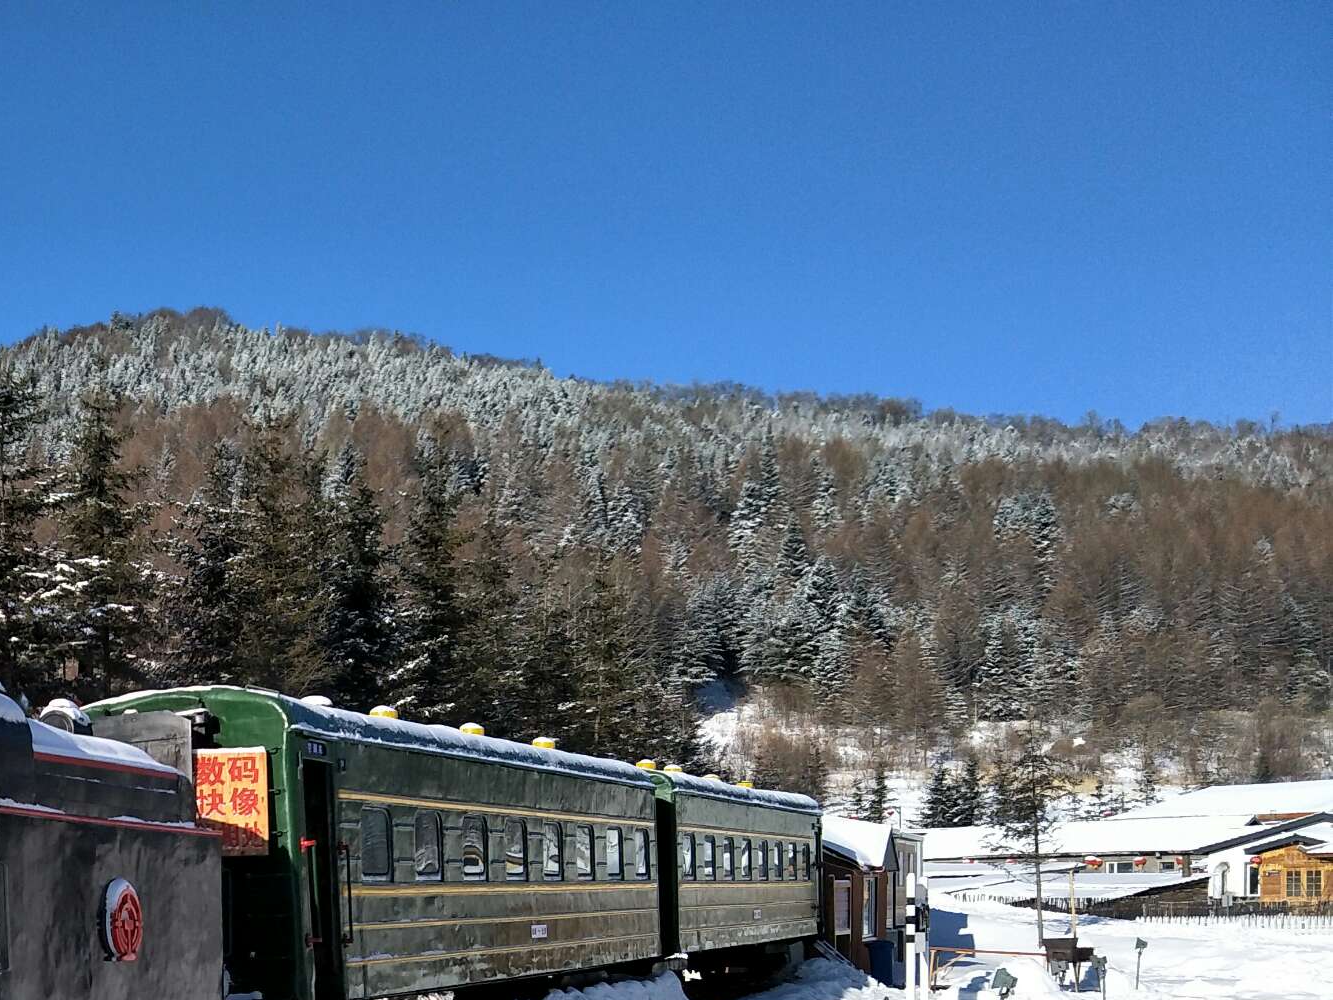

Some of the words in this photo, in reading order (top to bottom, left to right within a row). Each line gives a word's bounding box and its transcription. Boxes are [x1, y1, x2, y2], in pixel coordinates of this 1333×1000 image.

[196, 757, 258, 786] 数码
[196, 788, 260, 816] 快像
[199, 819, 264, 849] 相处
